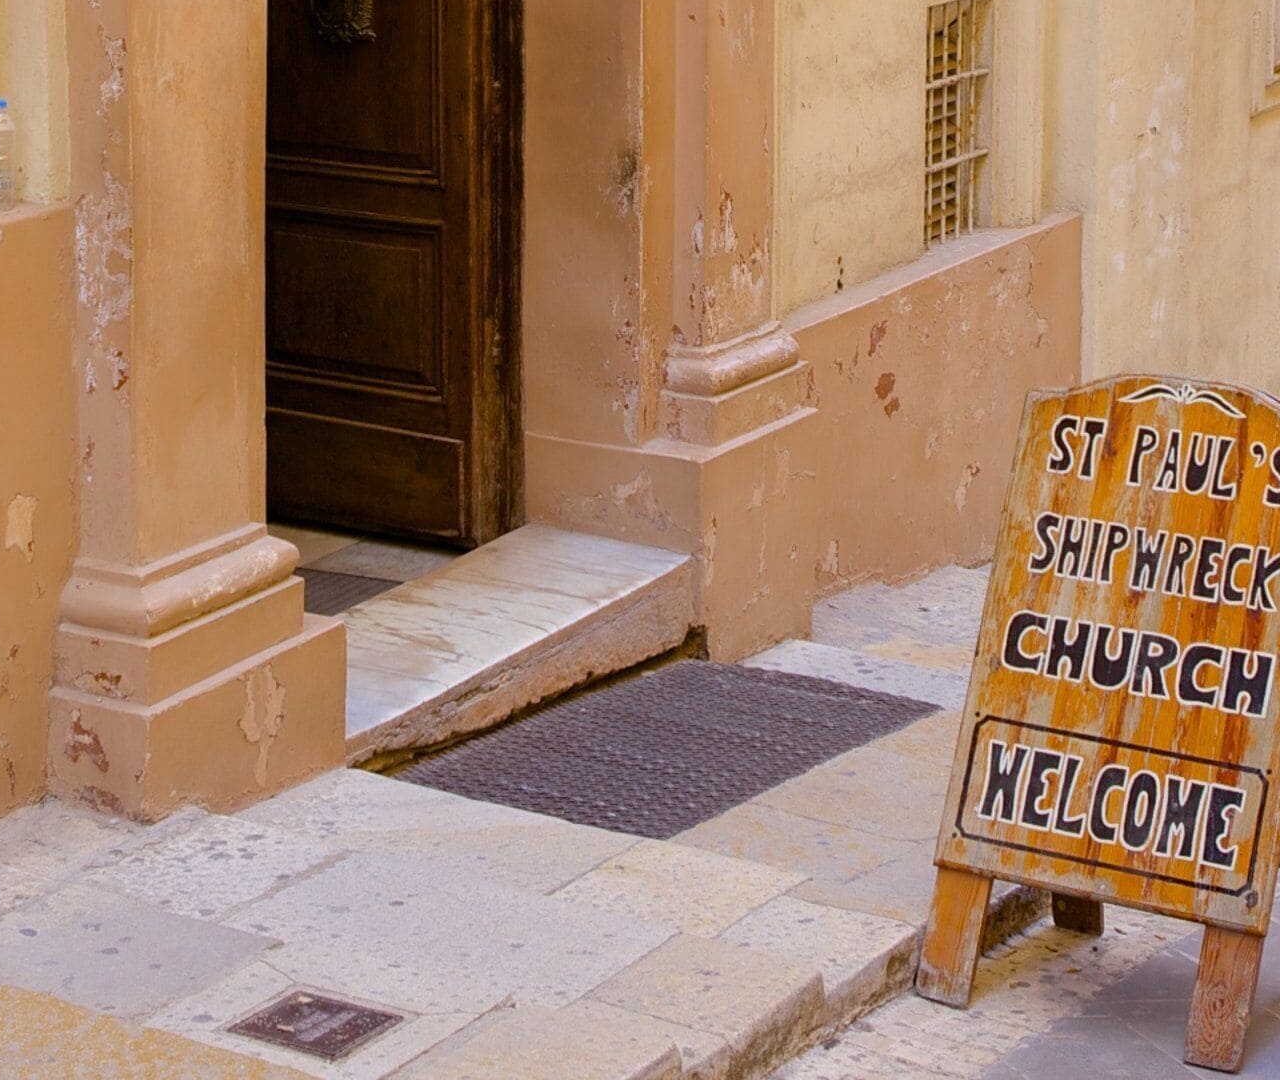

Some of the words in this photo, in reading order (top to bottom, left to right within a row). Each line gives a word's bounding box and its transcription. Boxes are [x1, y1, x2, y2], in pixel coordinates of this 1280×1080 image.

[1047, 414, 1108, 480] ST
[1001, 610, 1276, 719] CHURCH
[977, 740, 1248, 872] WELCOME
